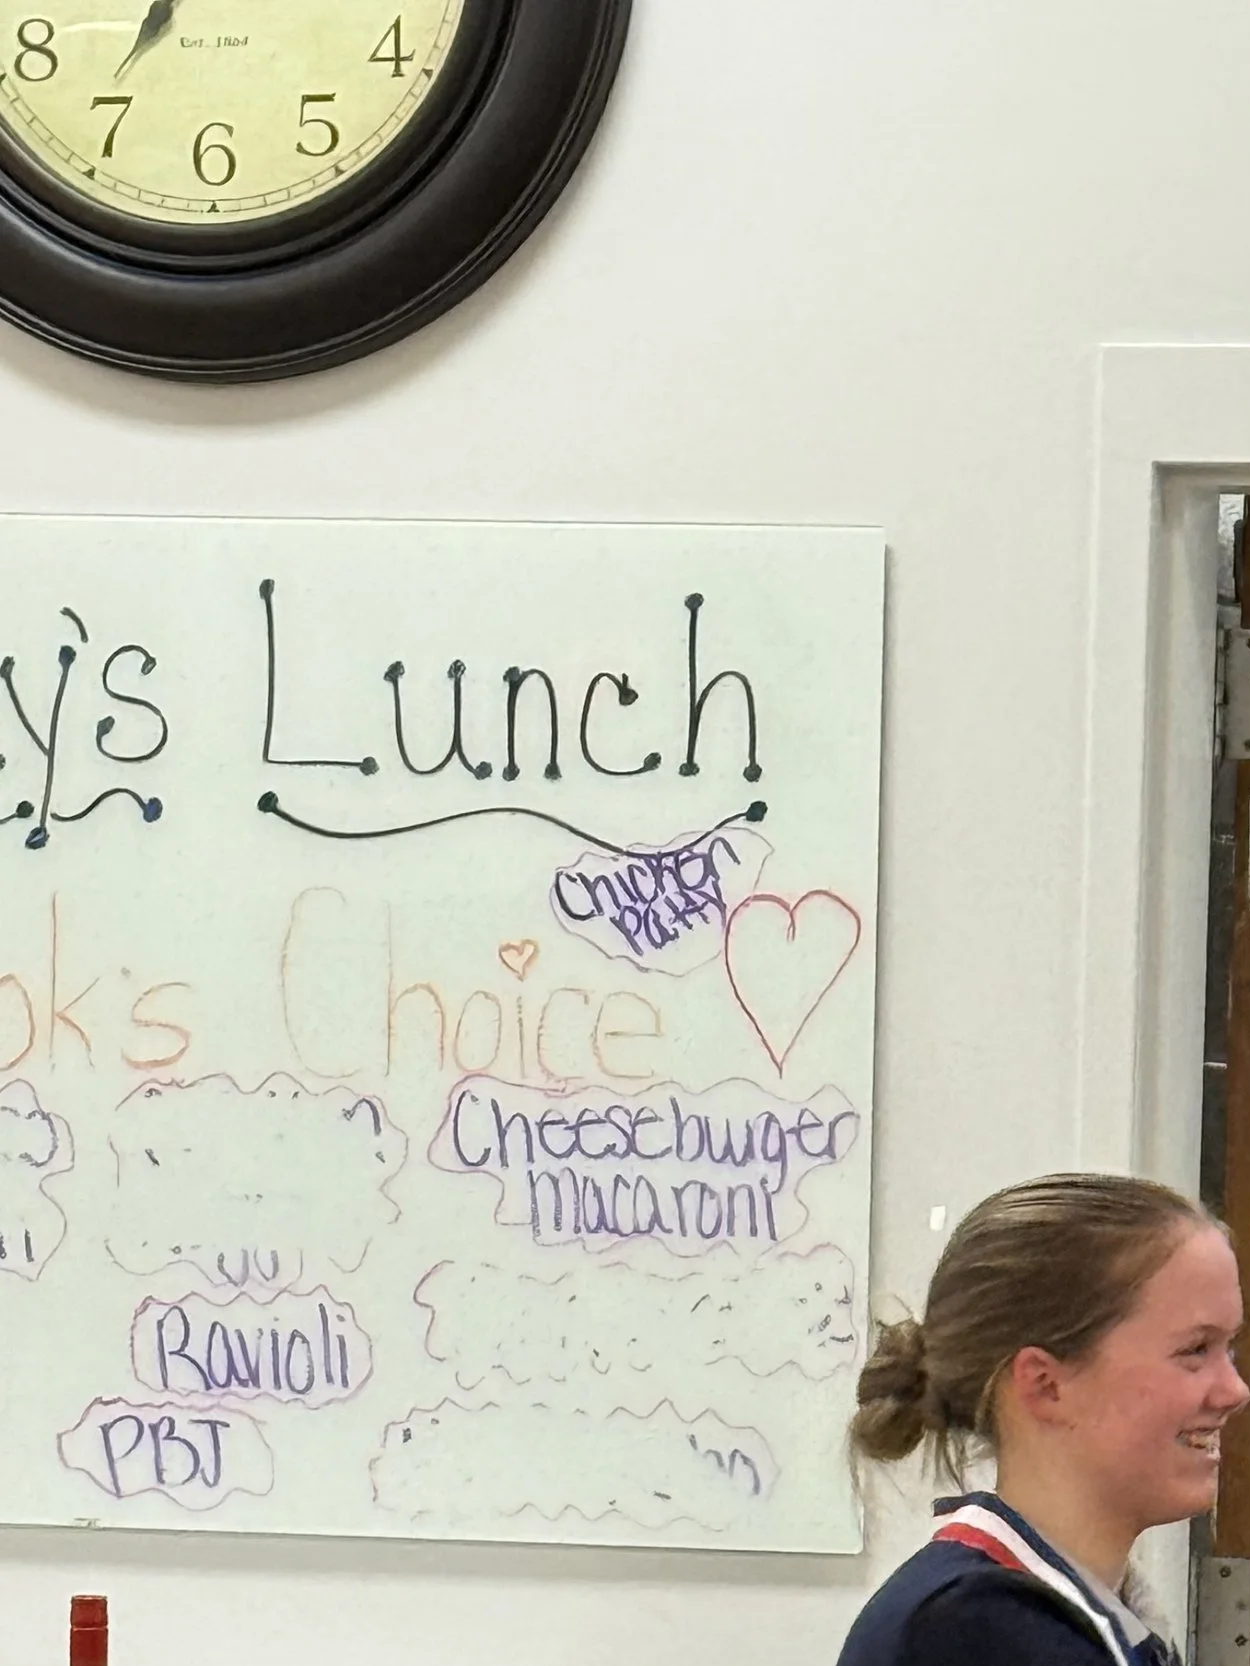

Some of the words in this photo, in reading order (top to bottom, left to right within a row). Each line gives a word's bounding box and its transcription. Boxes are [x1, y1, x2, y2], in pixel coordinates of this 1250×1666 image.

[13, 18, 59, 83] 8
[367, 14, 416, 78] 4
[90, 95, 134, 158] 7
[193, 122, 237, 187] 6
[295, 92, 339, 157] 5
[258, 578, 763, 782] Lunch
[280, 885, 664, 1079] Choice
[156, 1302, 350, 1395] Ravioli
[98, 1414, 231, 1498] PBJ
